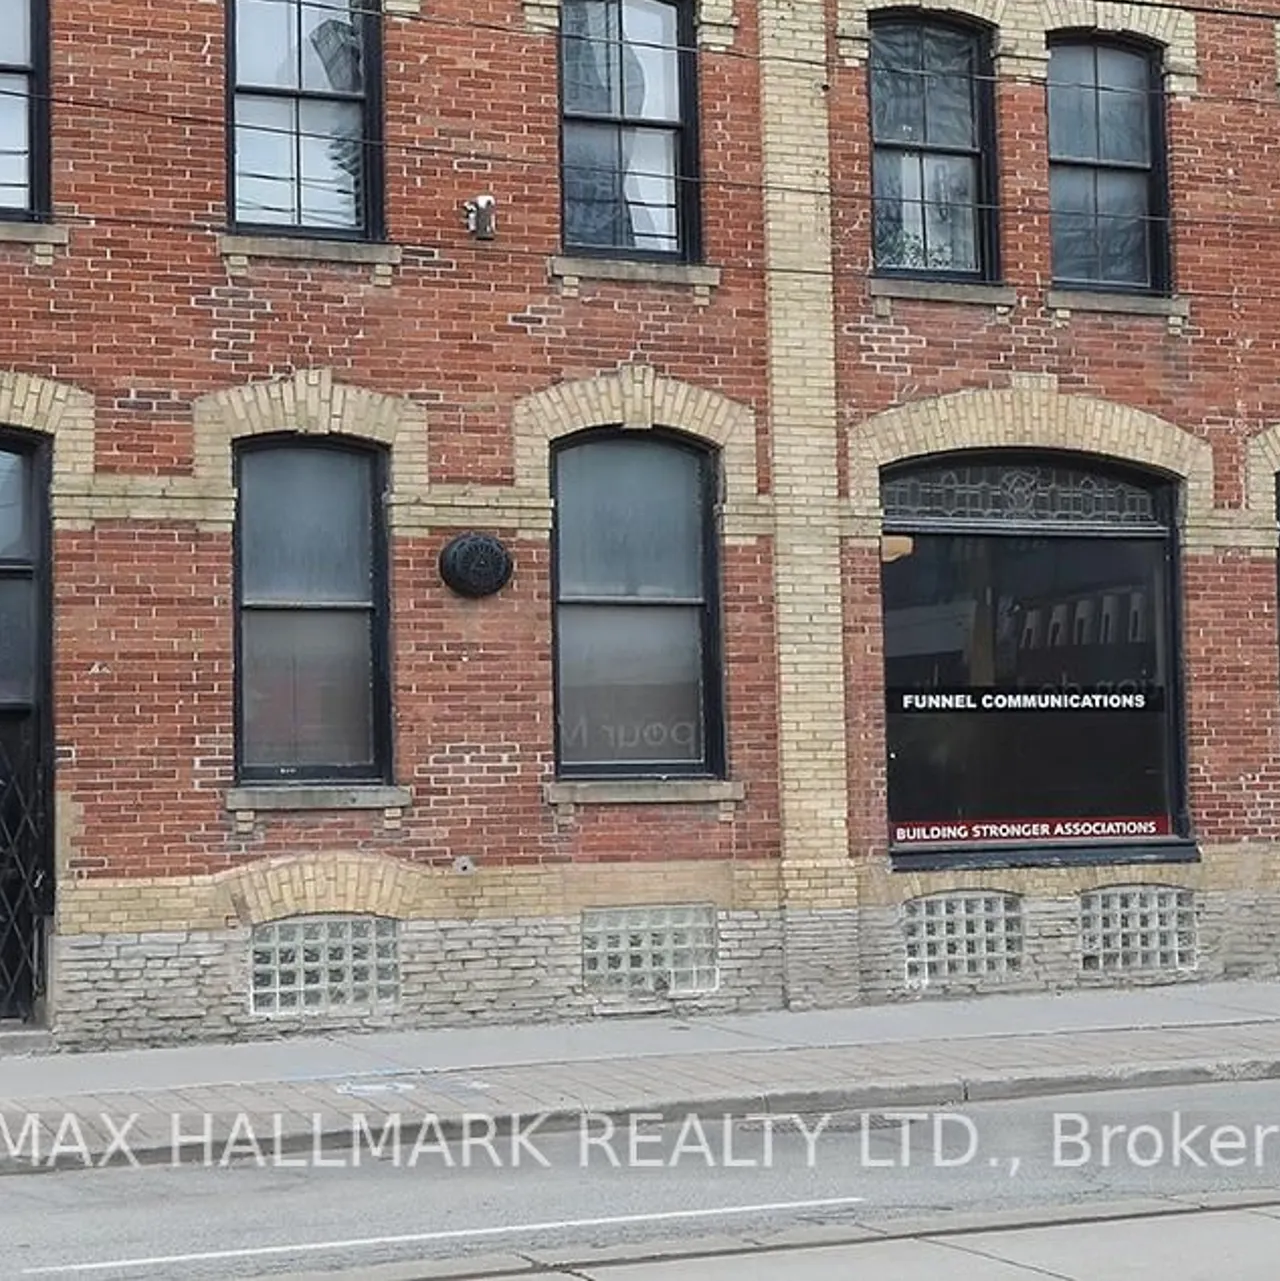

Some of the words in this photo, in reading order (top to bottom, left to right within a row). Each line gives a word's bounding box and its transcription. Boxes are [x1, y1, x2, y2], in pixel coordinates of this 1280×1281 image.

[902, 693, 977, 709] FUNNEL
[981, 693, 1146, 709] COMMUNICATIONS
[896, 825, 968, 840] BUILDING
[972, 823, 1050, 838] STRONGER
[1054, 821, 1157, 836] ASSOCIATIONS
